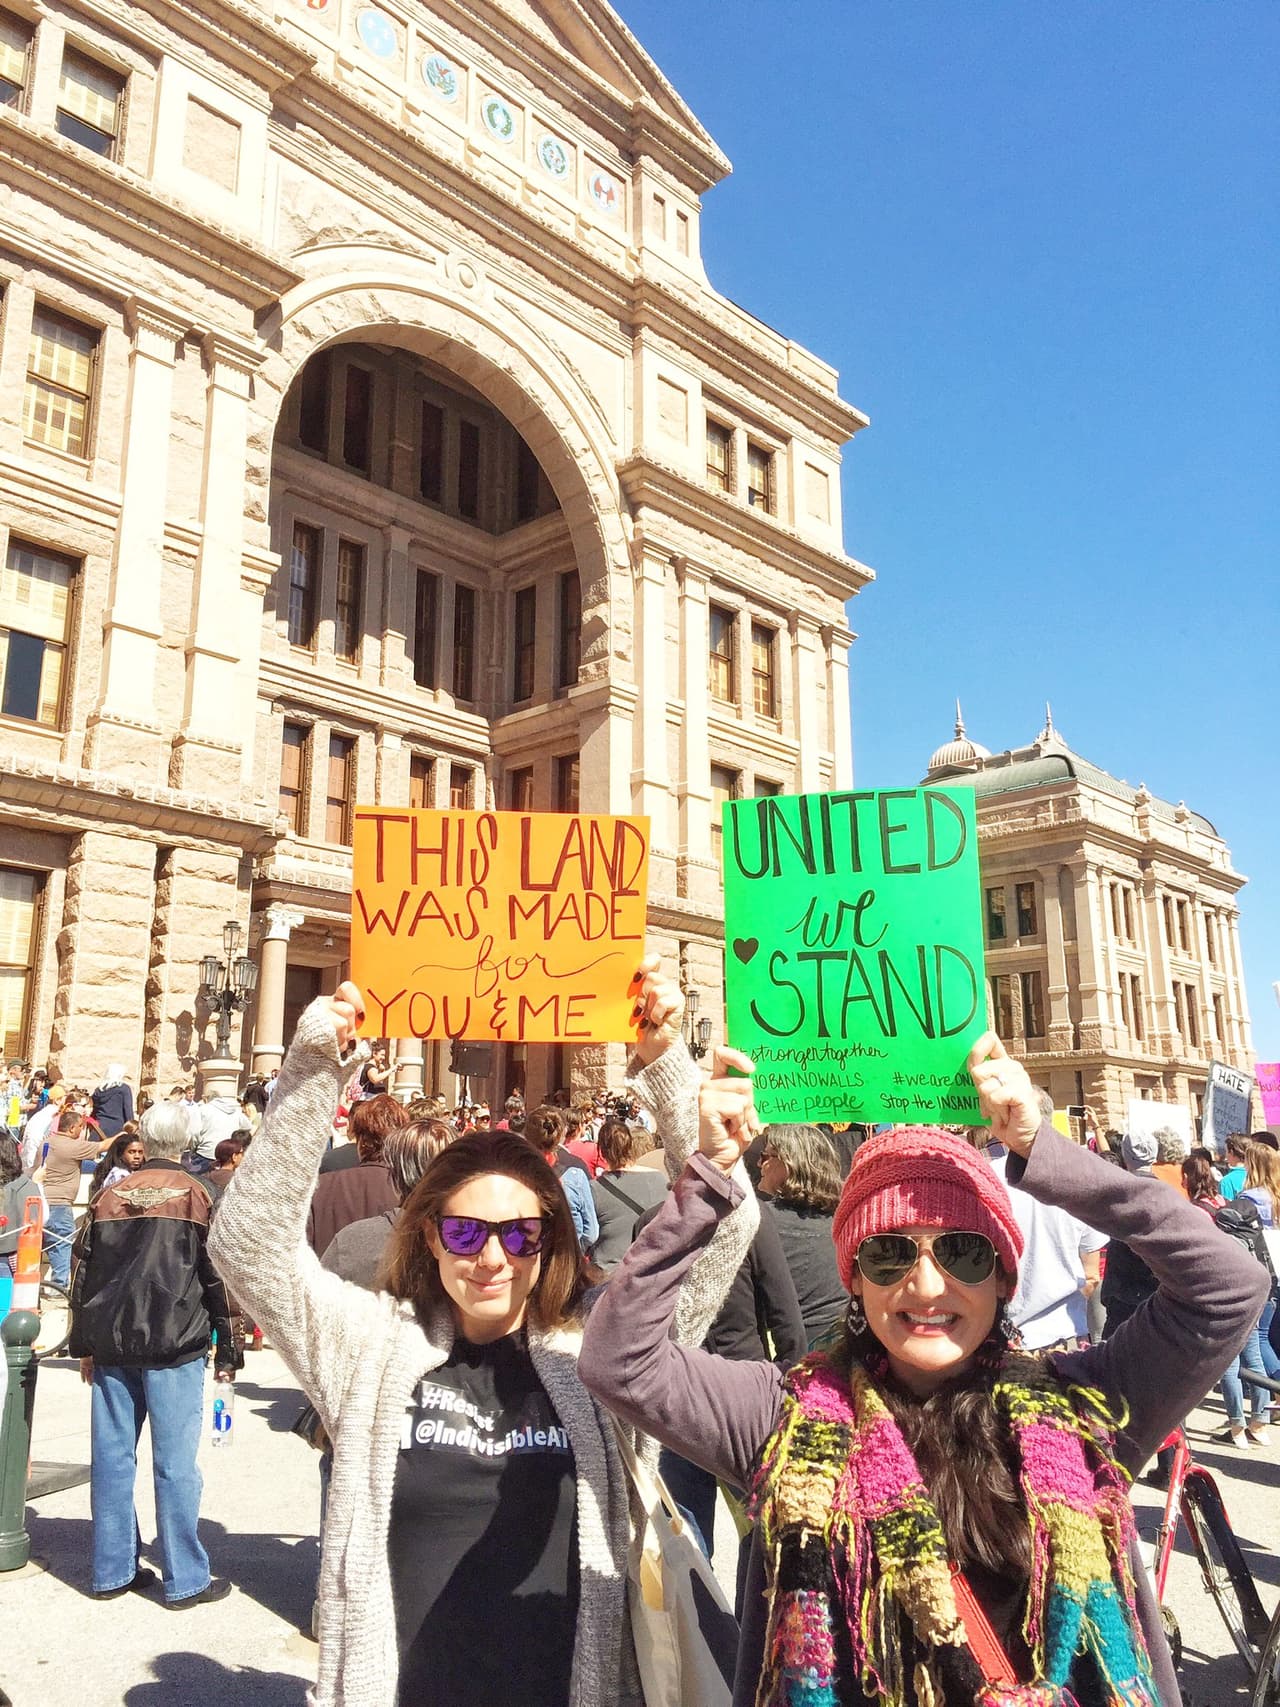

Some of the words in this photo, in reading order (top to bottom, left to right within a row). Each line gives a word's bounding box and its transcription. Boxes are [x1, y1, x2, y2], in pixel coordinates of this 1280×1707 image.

[355, 813, 498, 887] THIS
[520, 818, 645, 891] LAND
[731, 790, 966, 879] UNITED
[356, 885, 488, 940] WAS
[509, 890, 642, 940] MADE
[785, 889, 889, 948] we
[367, 989, 471, 1039] YOU
[750, 945, 978, 1039] STAND
[773, 1097, 801, 1113] the
[804, 1092, 864, 1120] people
[880, 1092, 909, 1114] Stop
[912, 1094, 936, 1110] the
[1218, 1069, 1246, 1093] HATE
